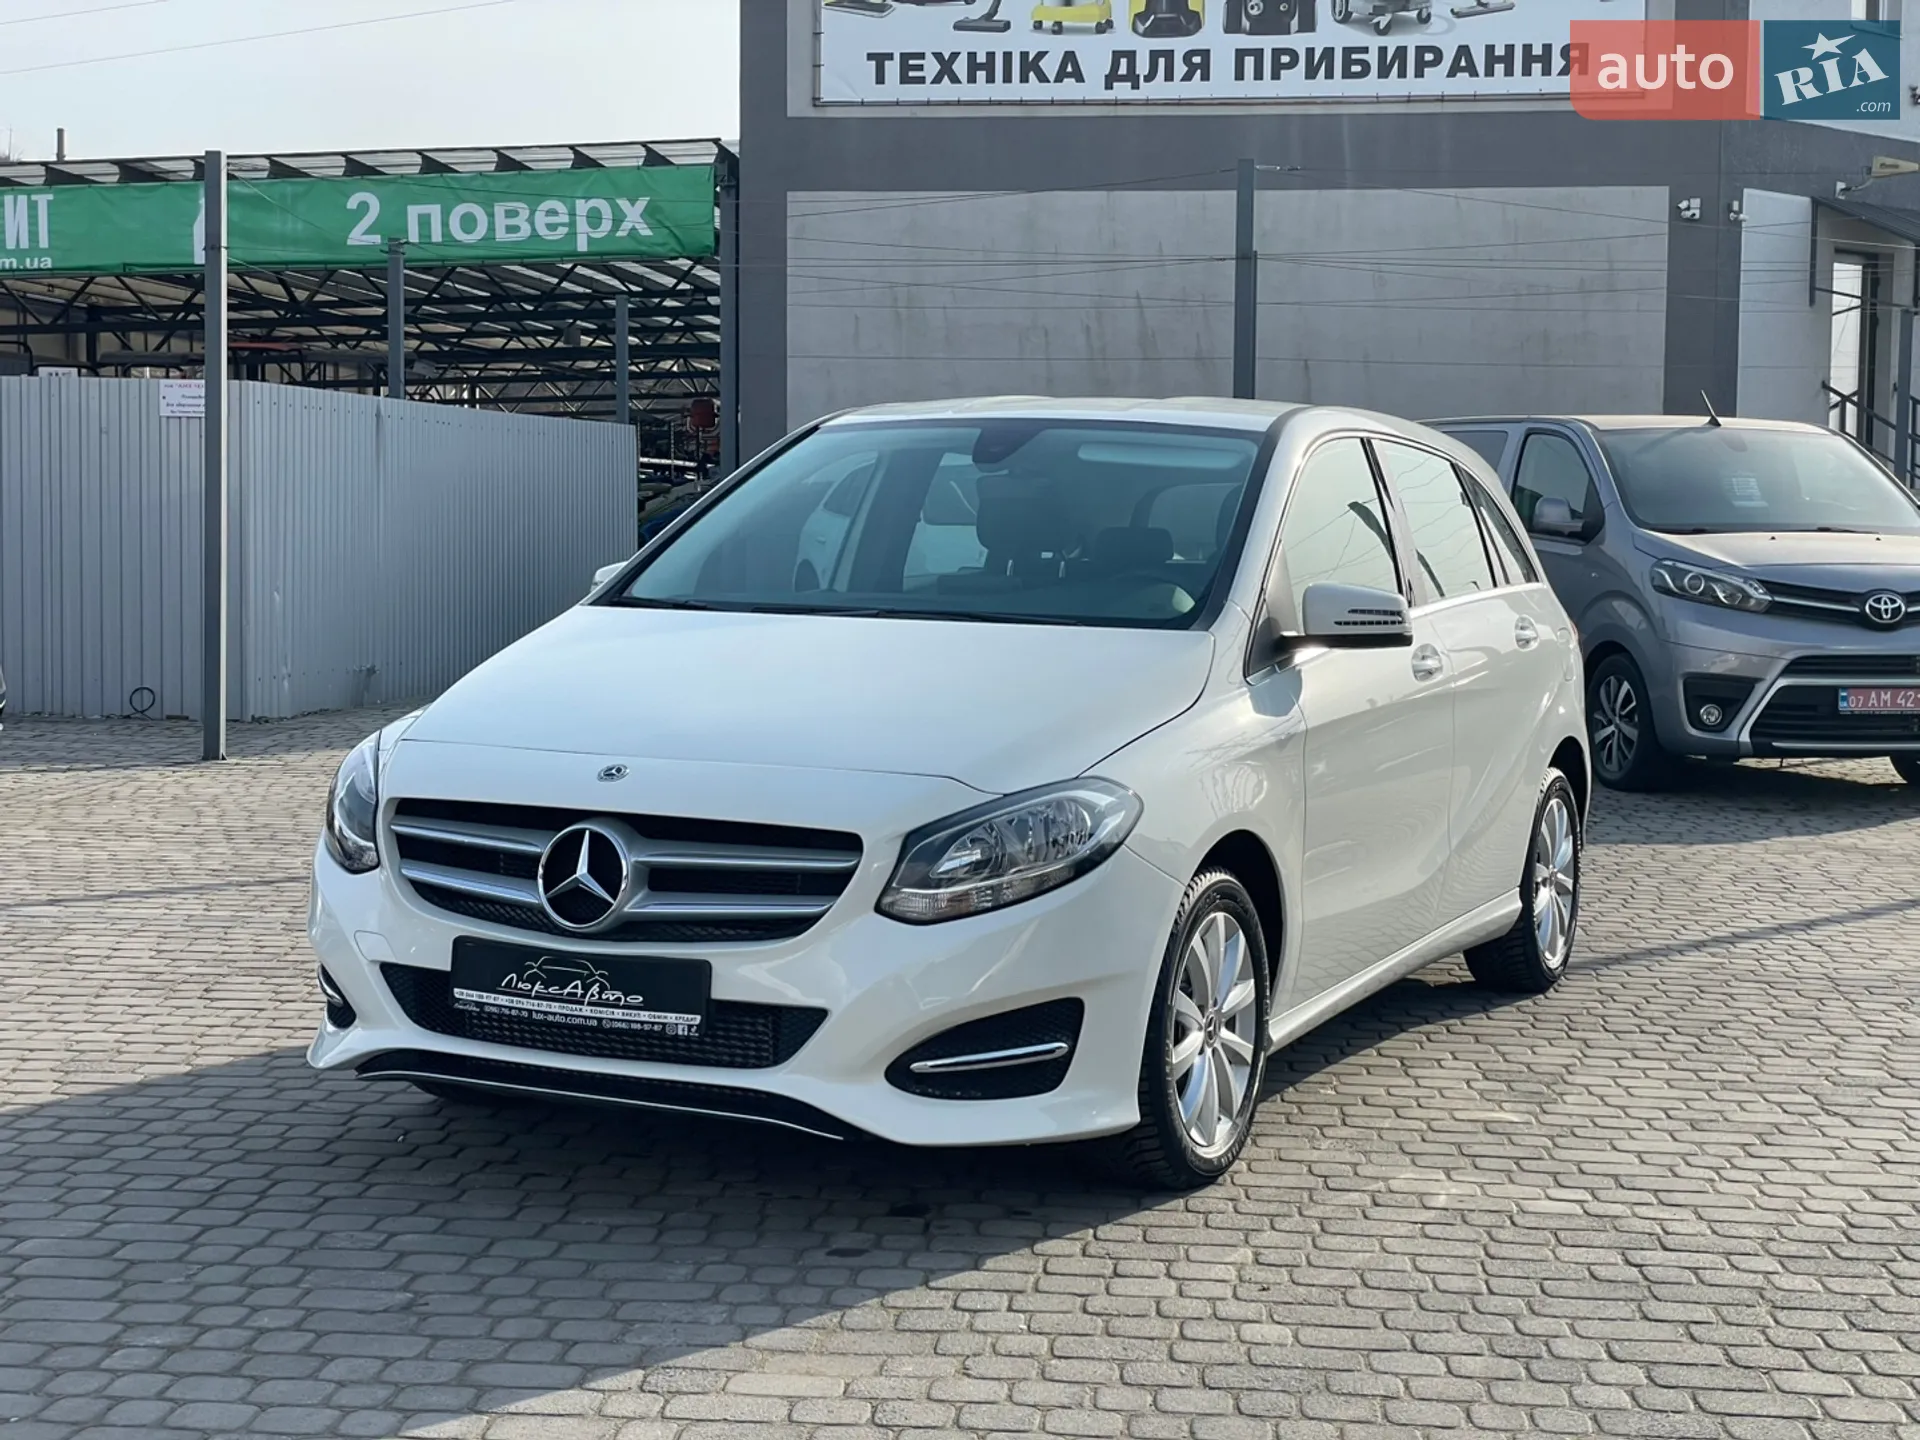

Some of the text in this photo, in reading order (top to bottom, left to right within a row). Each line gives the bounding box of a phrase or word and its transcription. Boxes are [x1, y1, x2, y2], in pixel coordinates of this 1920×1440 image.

[866, 42, 1590, 91] ТЕХНІКА ДЛЯ ПРИБИРАННЯ
[345, 191, 654, 252] 2 поверх
[1849, 695, 1864, 708] 07
[532, 1011, 598, 1026] lux-auto.com.ua
